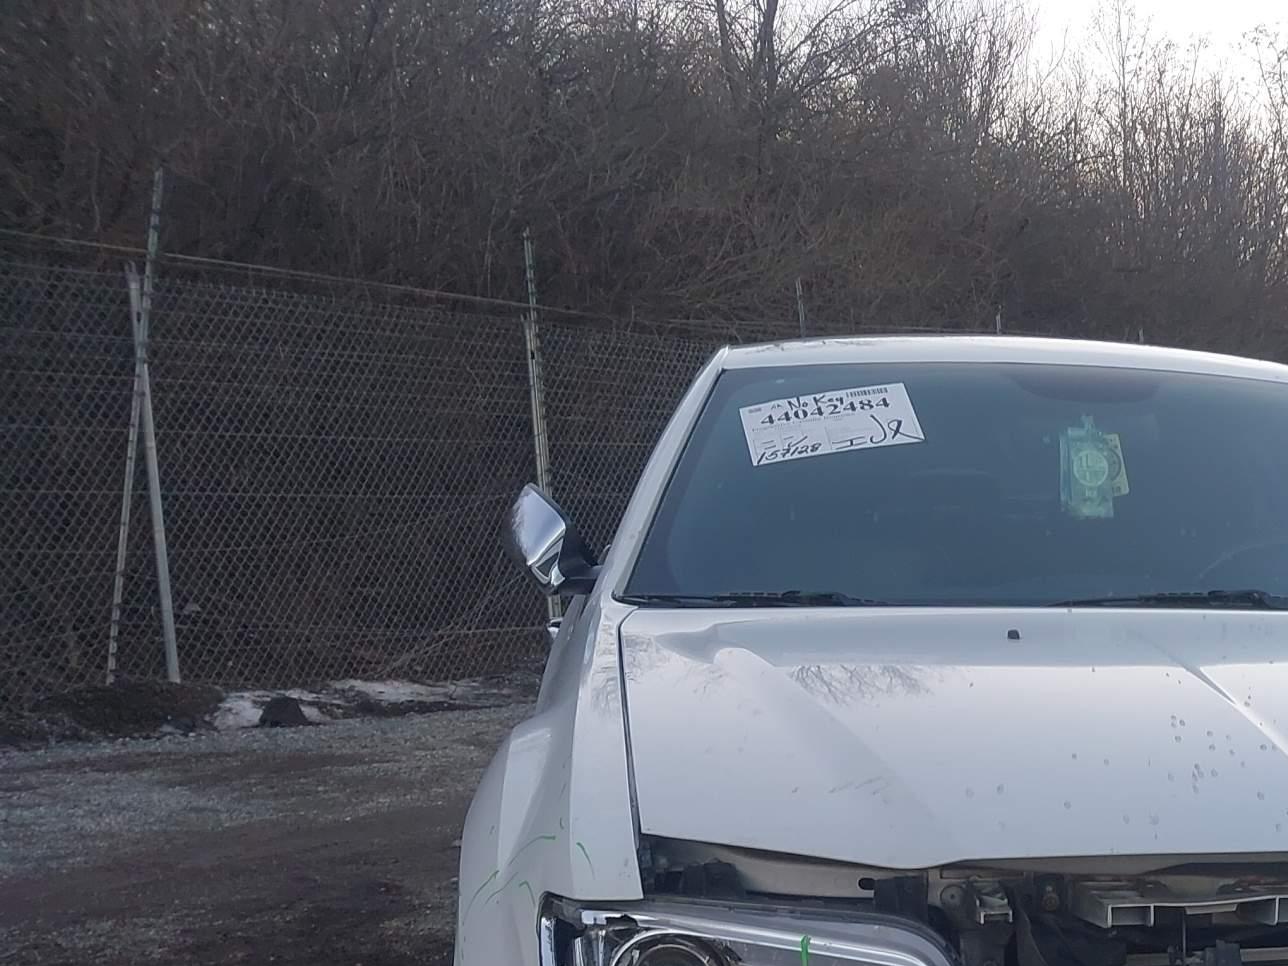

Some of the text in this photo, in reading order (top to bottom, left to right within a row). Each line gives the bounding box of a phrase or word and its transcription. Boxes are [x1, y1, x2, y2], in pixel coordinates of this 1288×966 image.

[760, 397, 890, 425] 44042484
[787, 396, 809, 411] No
[813, 394, 844, 407] Key
